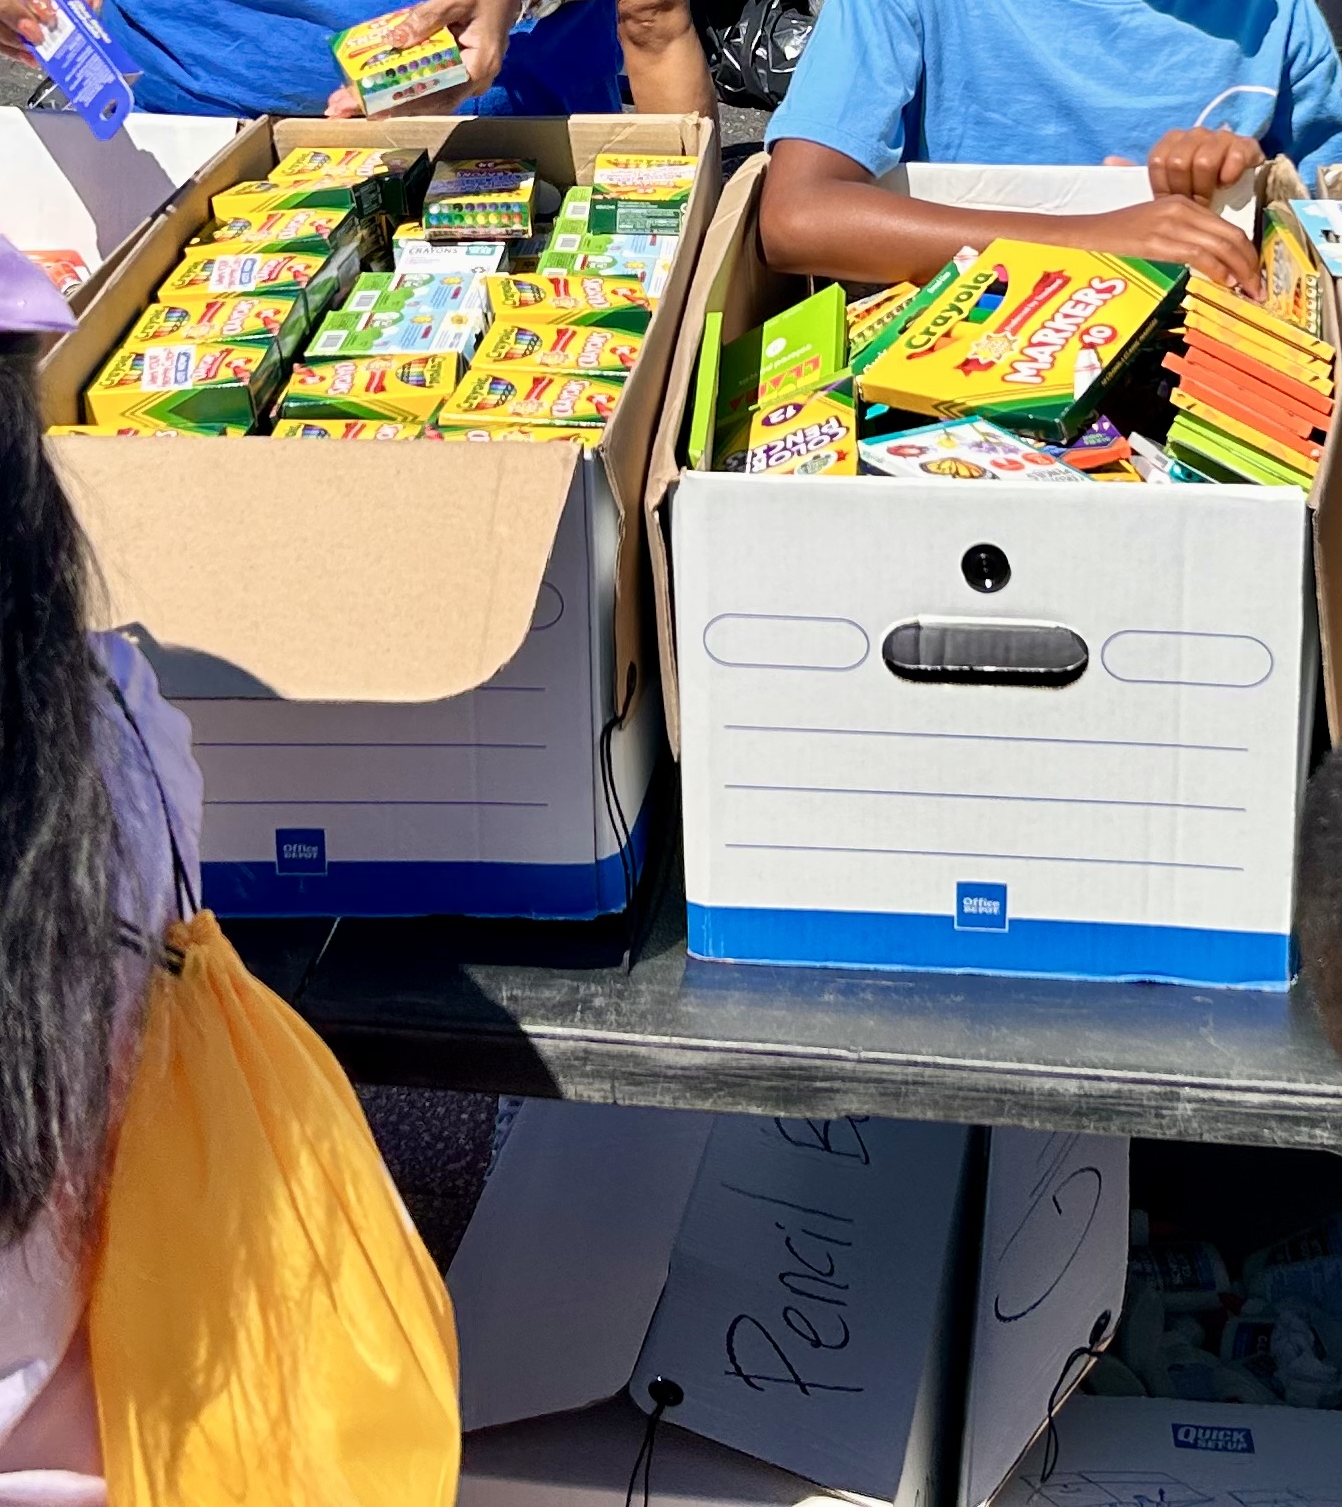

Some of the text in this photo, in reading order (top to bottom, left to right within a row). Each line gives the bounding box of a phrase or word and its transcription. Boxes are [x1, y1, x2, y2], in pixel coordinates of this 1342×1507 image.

[408, 245, 458, 255] CRAYONS
[906, 271, 993, 350] Crayola
[1003, 276, 1130, 384] MARKERS
[1084, 325, 1113, 347] 10
[769, 404, 797, 426] 12
[283, 844, 319, 853] Office
[962, 897, 1000, 907] Office
[721, 1180, 865, 1396] Pencil
[1177, 1424, 1248, 1444] QUICK
[1197, 1439, 1249, 1452] SETUP
